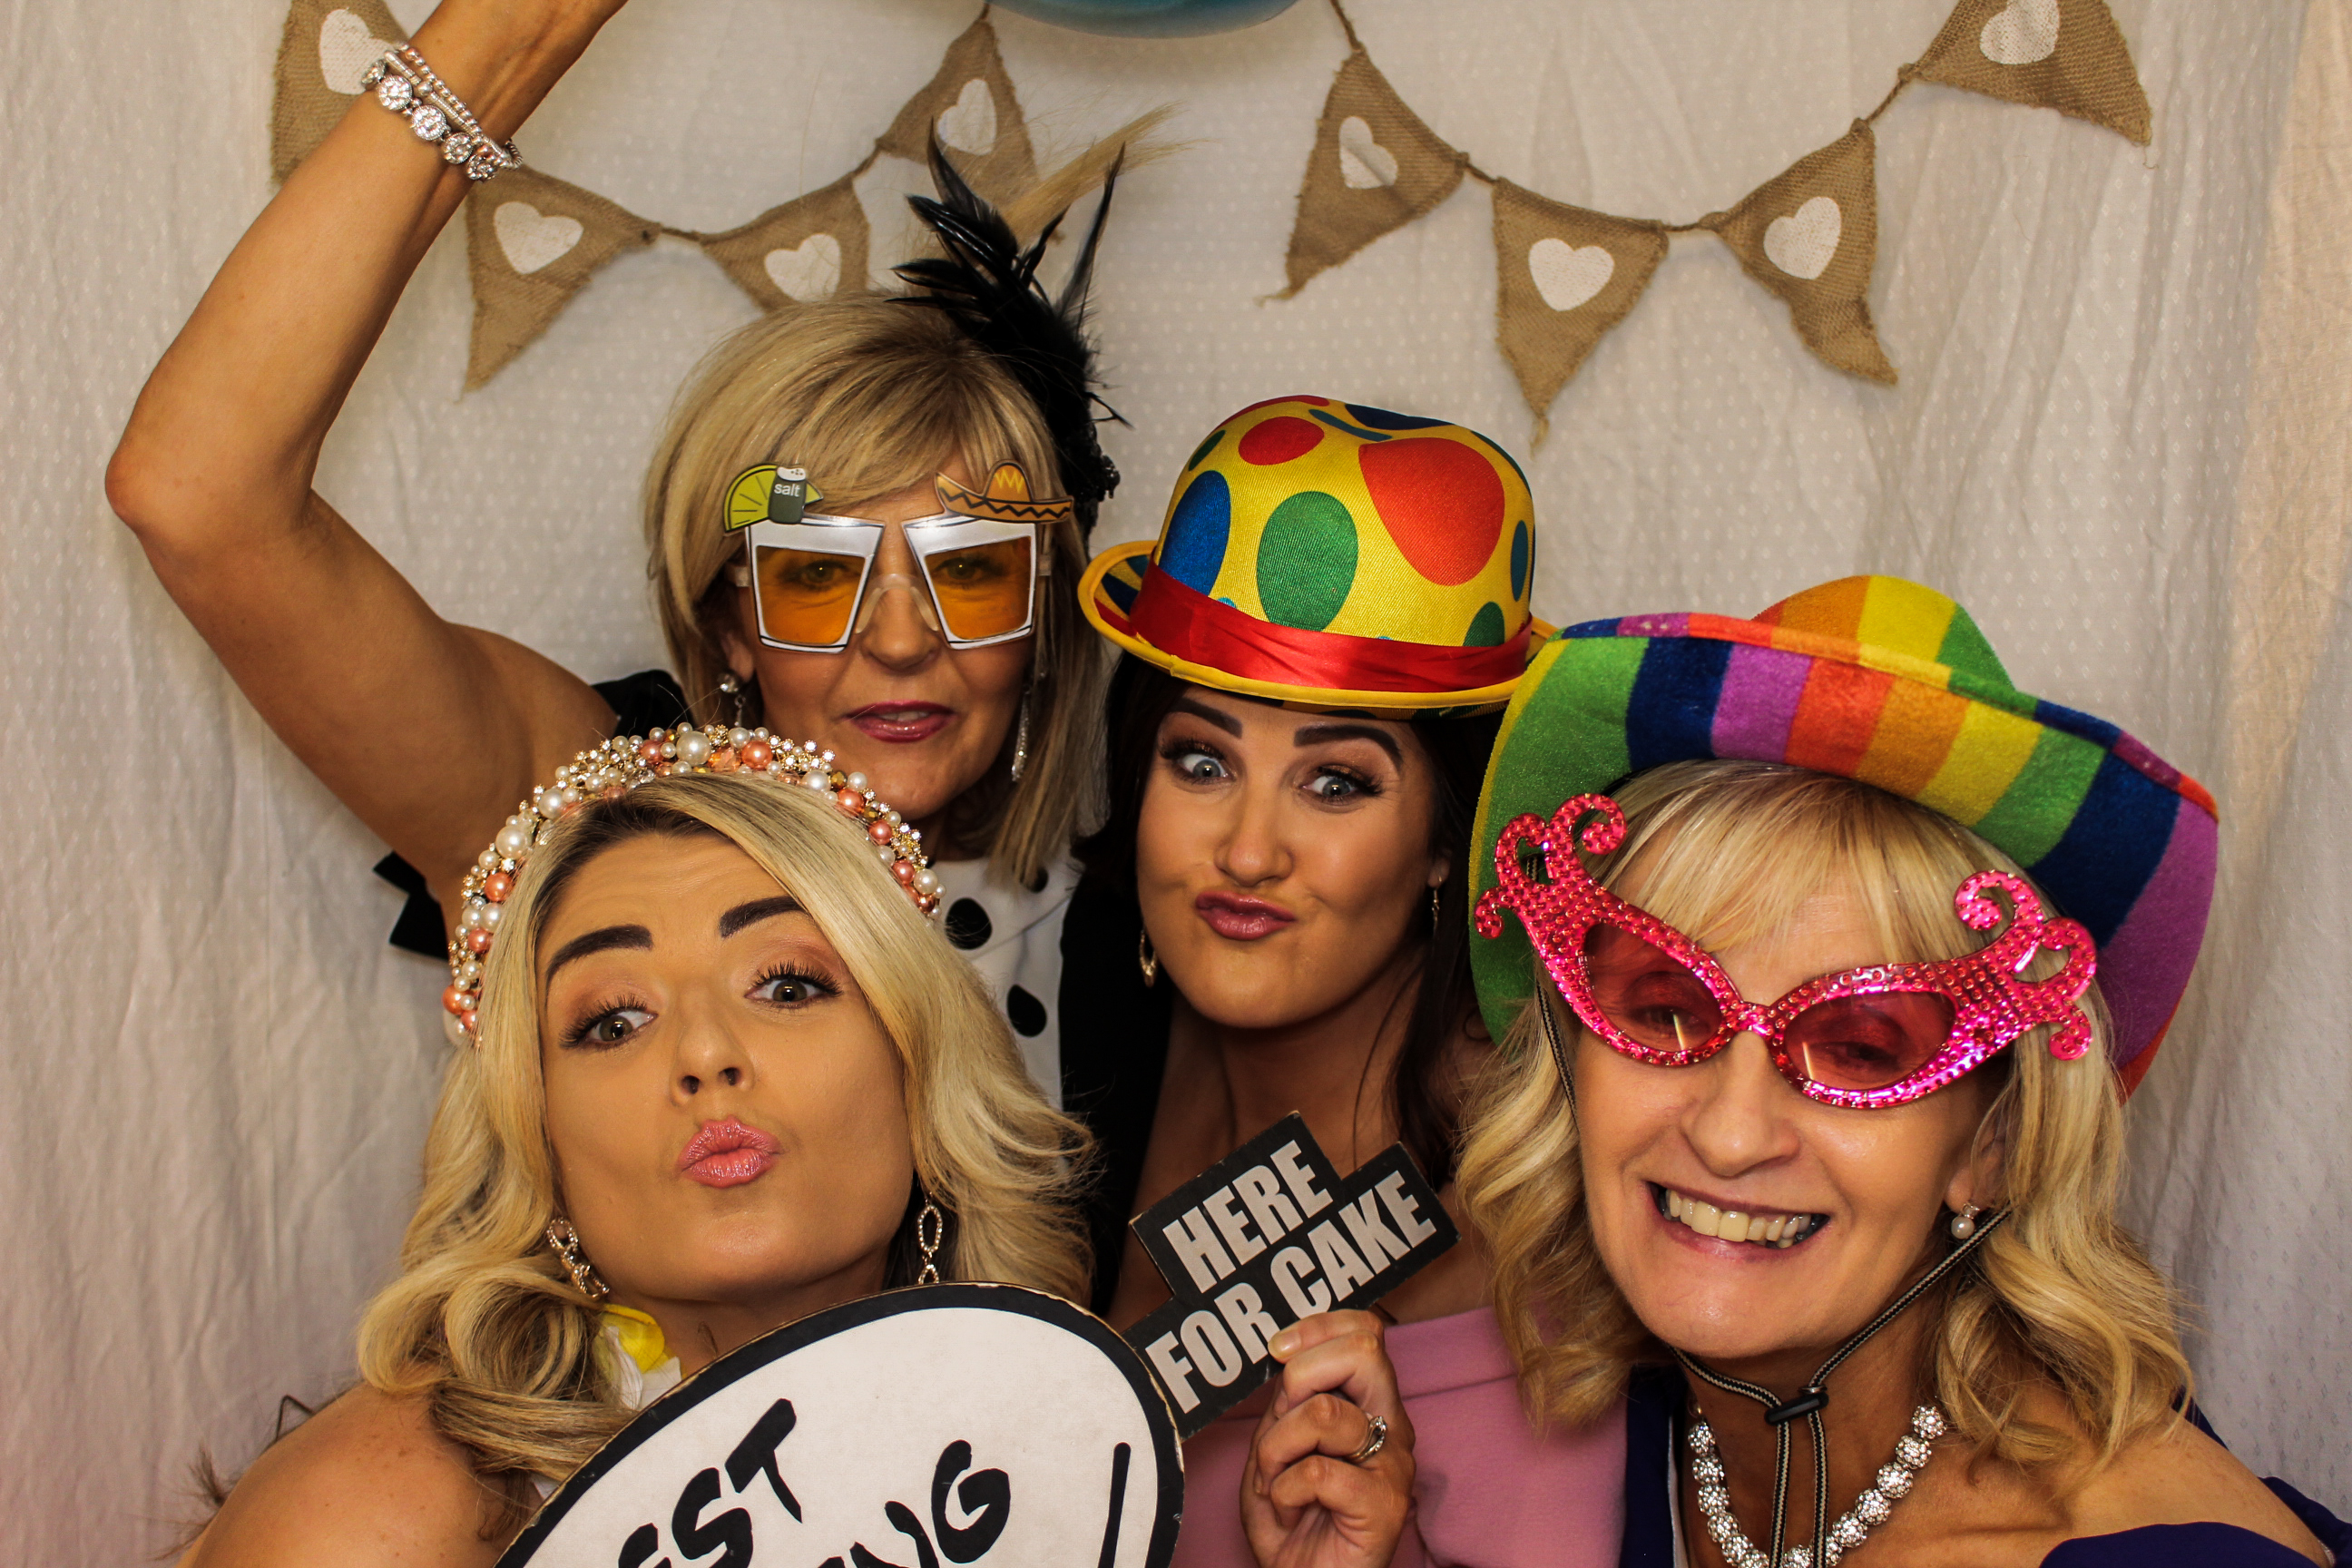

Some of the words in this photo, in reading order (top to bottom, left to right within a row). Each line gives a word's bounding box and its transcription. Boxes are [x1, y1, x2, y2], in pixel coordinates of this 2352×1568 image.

[774, 483, 800, 497] salt
[1145, 1282, 1280, 1414] FOR
[1270, 1170, 1436, 1320] CAKE
[1161, 1140, 1333, 1294] HERE
